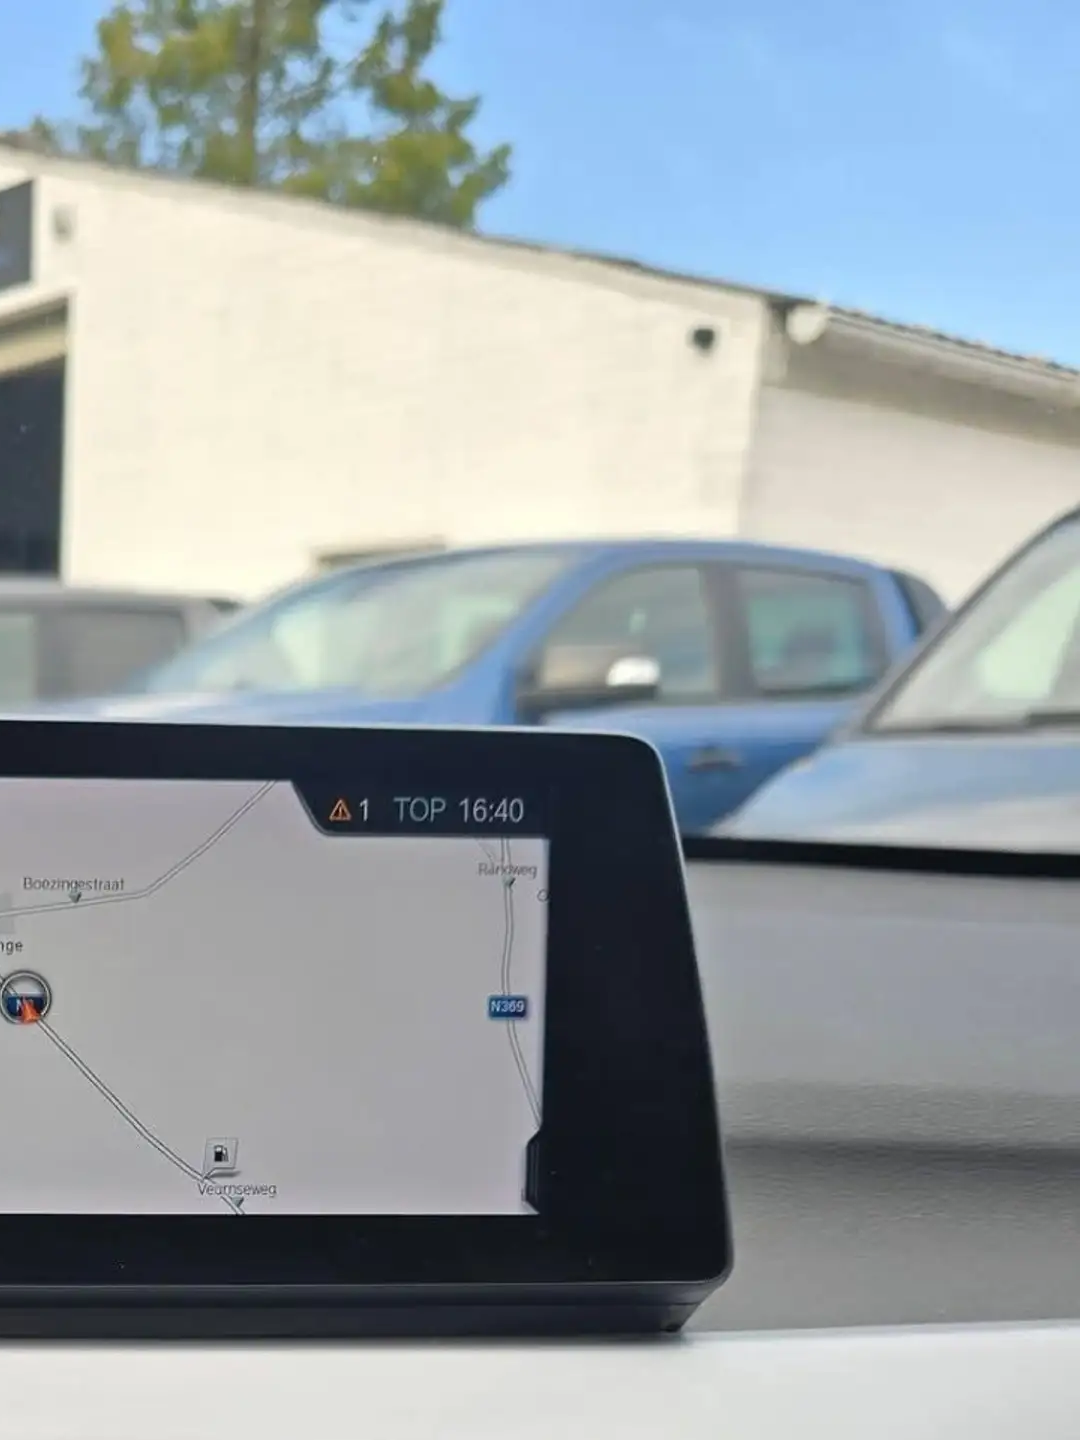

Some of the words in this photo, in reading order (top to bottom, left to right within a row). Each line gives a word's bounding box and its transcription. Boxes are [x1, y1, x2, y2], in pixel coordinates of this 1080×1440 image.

[358, 798, 371, 822] 1
[394, 797, 446, 823] TOP
[458, 798, 525, 823] 16:40
[490, 1002, 525, 1013] N369
